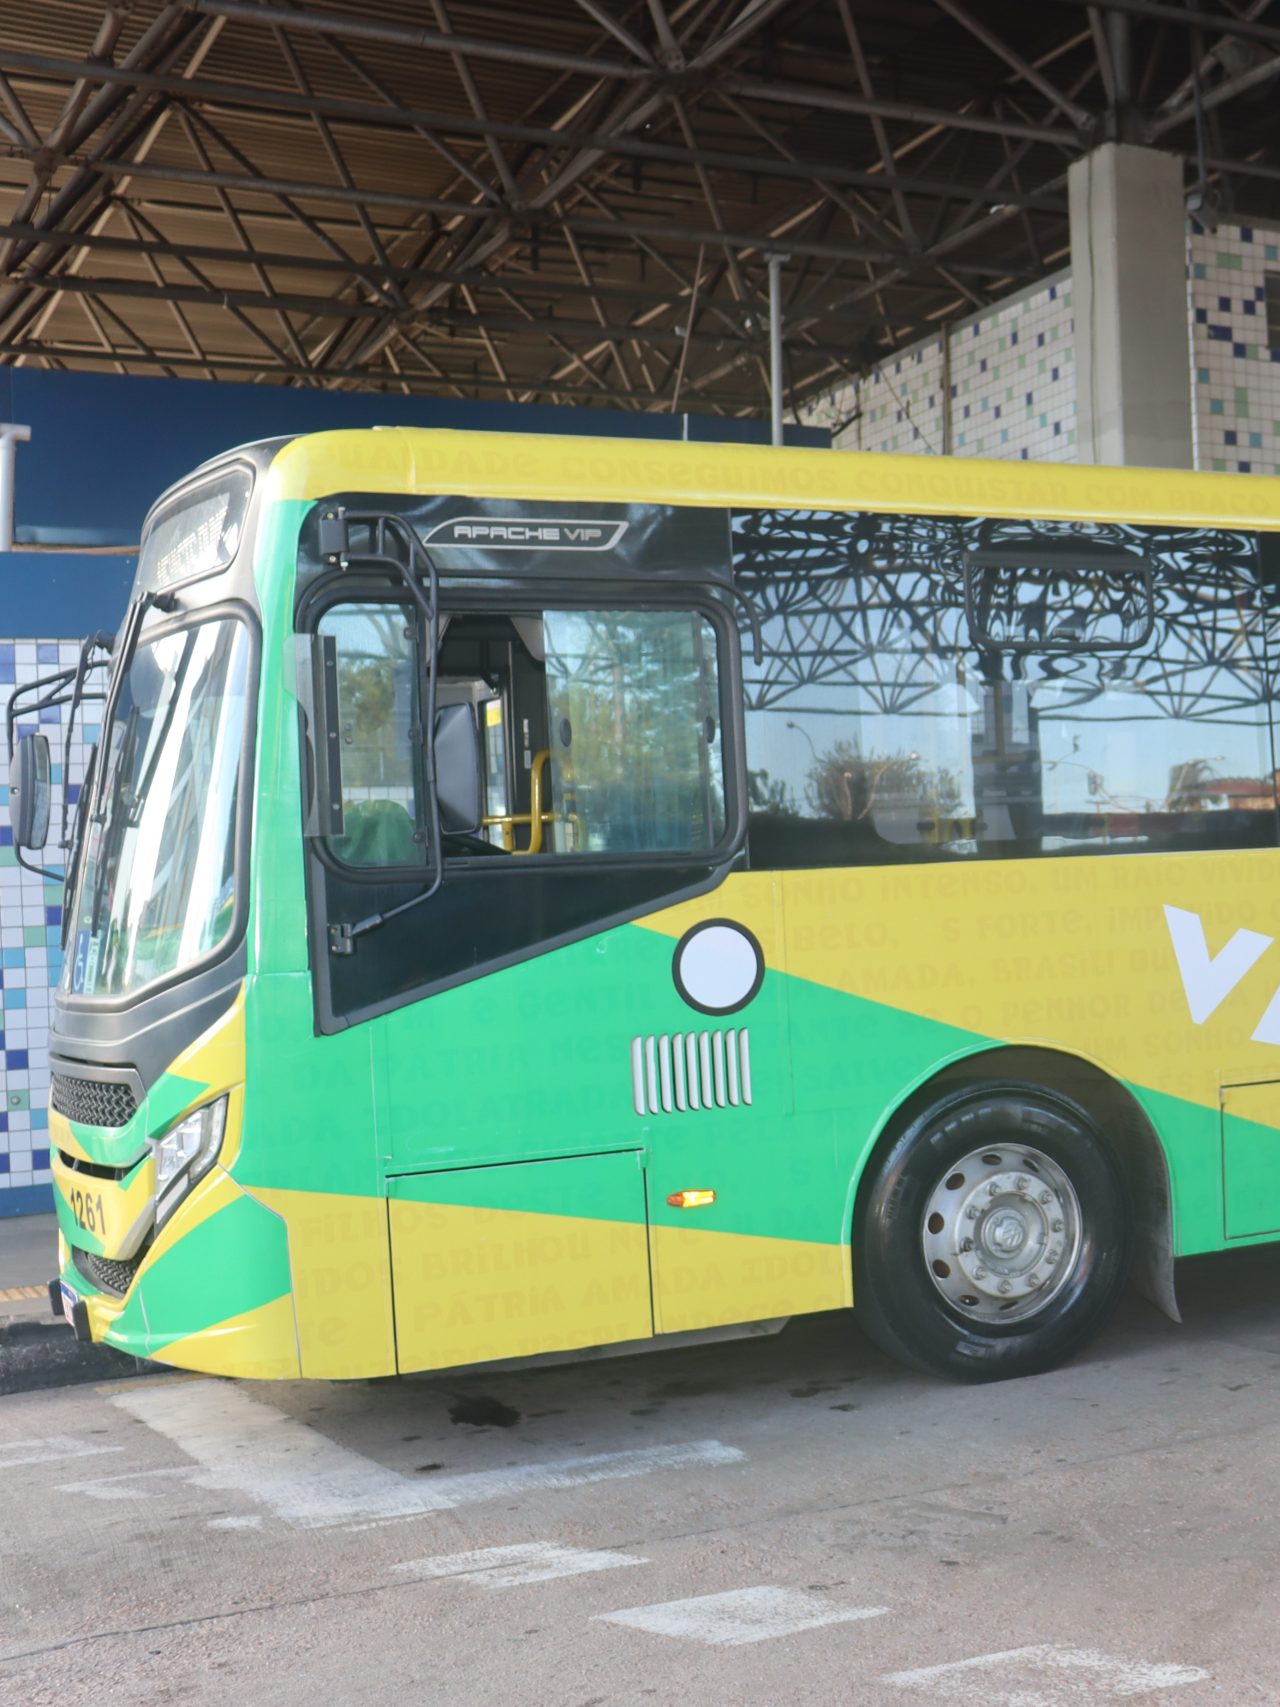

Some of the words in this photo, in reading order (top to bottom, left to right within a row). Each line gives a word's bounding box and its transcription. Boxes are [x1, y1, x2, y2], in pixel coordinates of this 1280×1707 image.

[453, 525, 560, 541] APACHE
[563, 528, 602, 542] VIP
[70, 1188, 106, 1235] 1261
